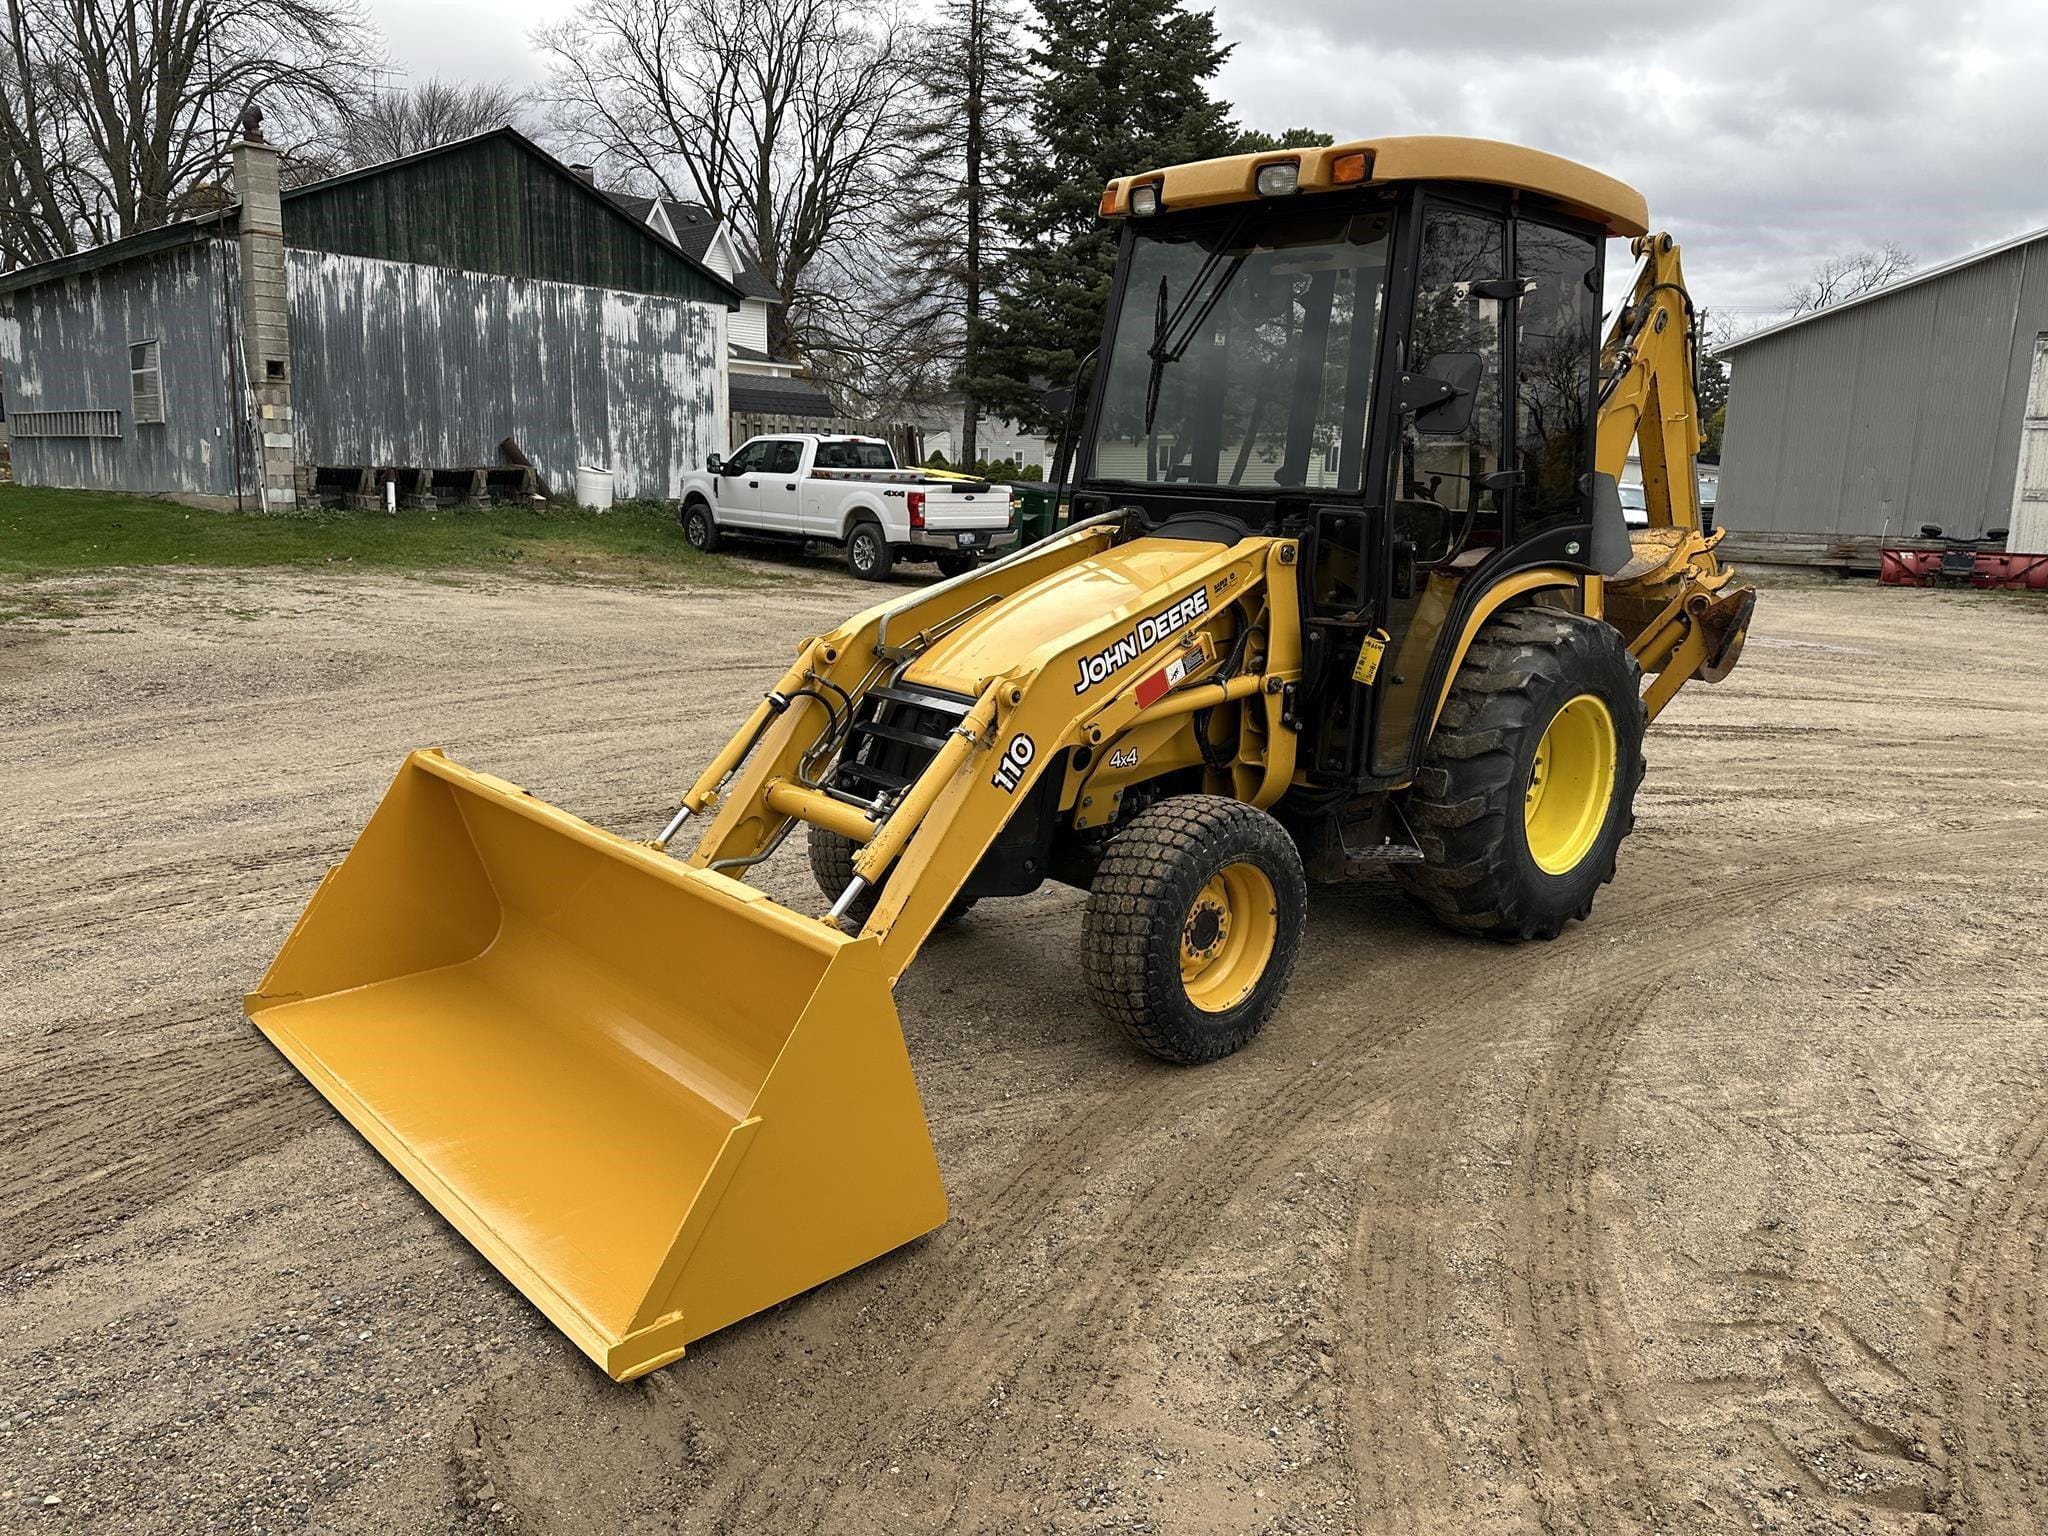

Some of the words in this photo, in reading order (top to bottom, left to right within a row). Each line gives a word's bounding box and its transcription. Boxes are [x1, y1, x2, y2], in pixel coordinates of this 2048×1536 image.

[1075, 631, 1138, 695] JOHN
[1136, 586, 1208, 653] DEERE
[992, 734, 1035, 794] 110
[1110, 747, 1138, 768] 4x4
